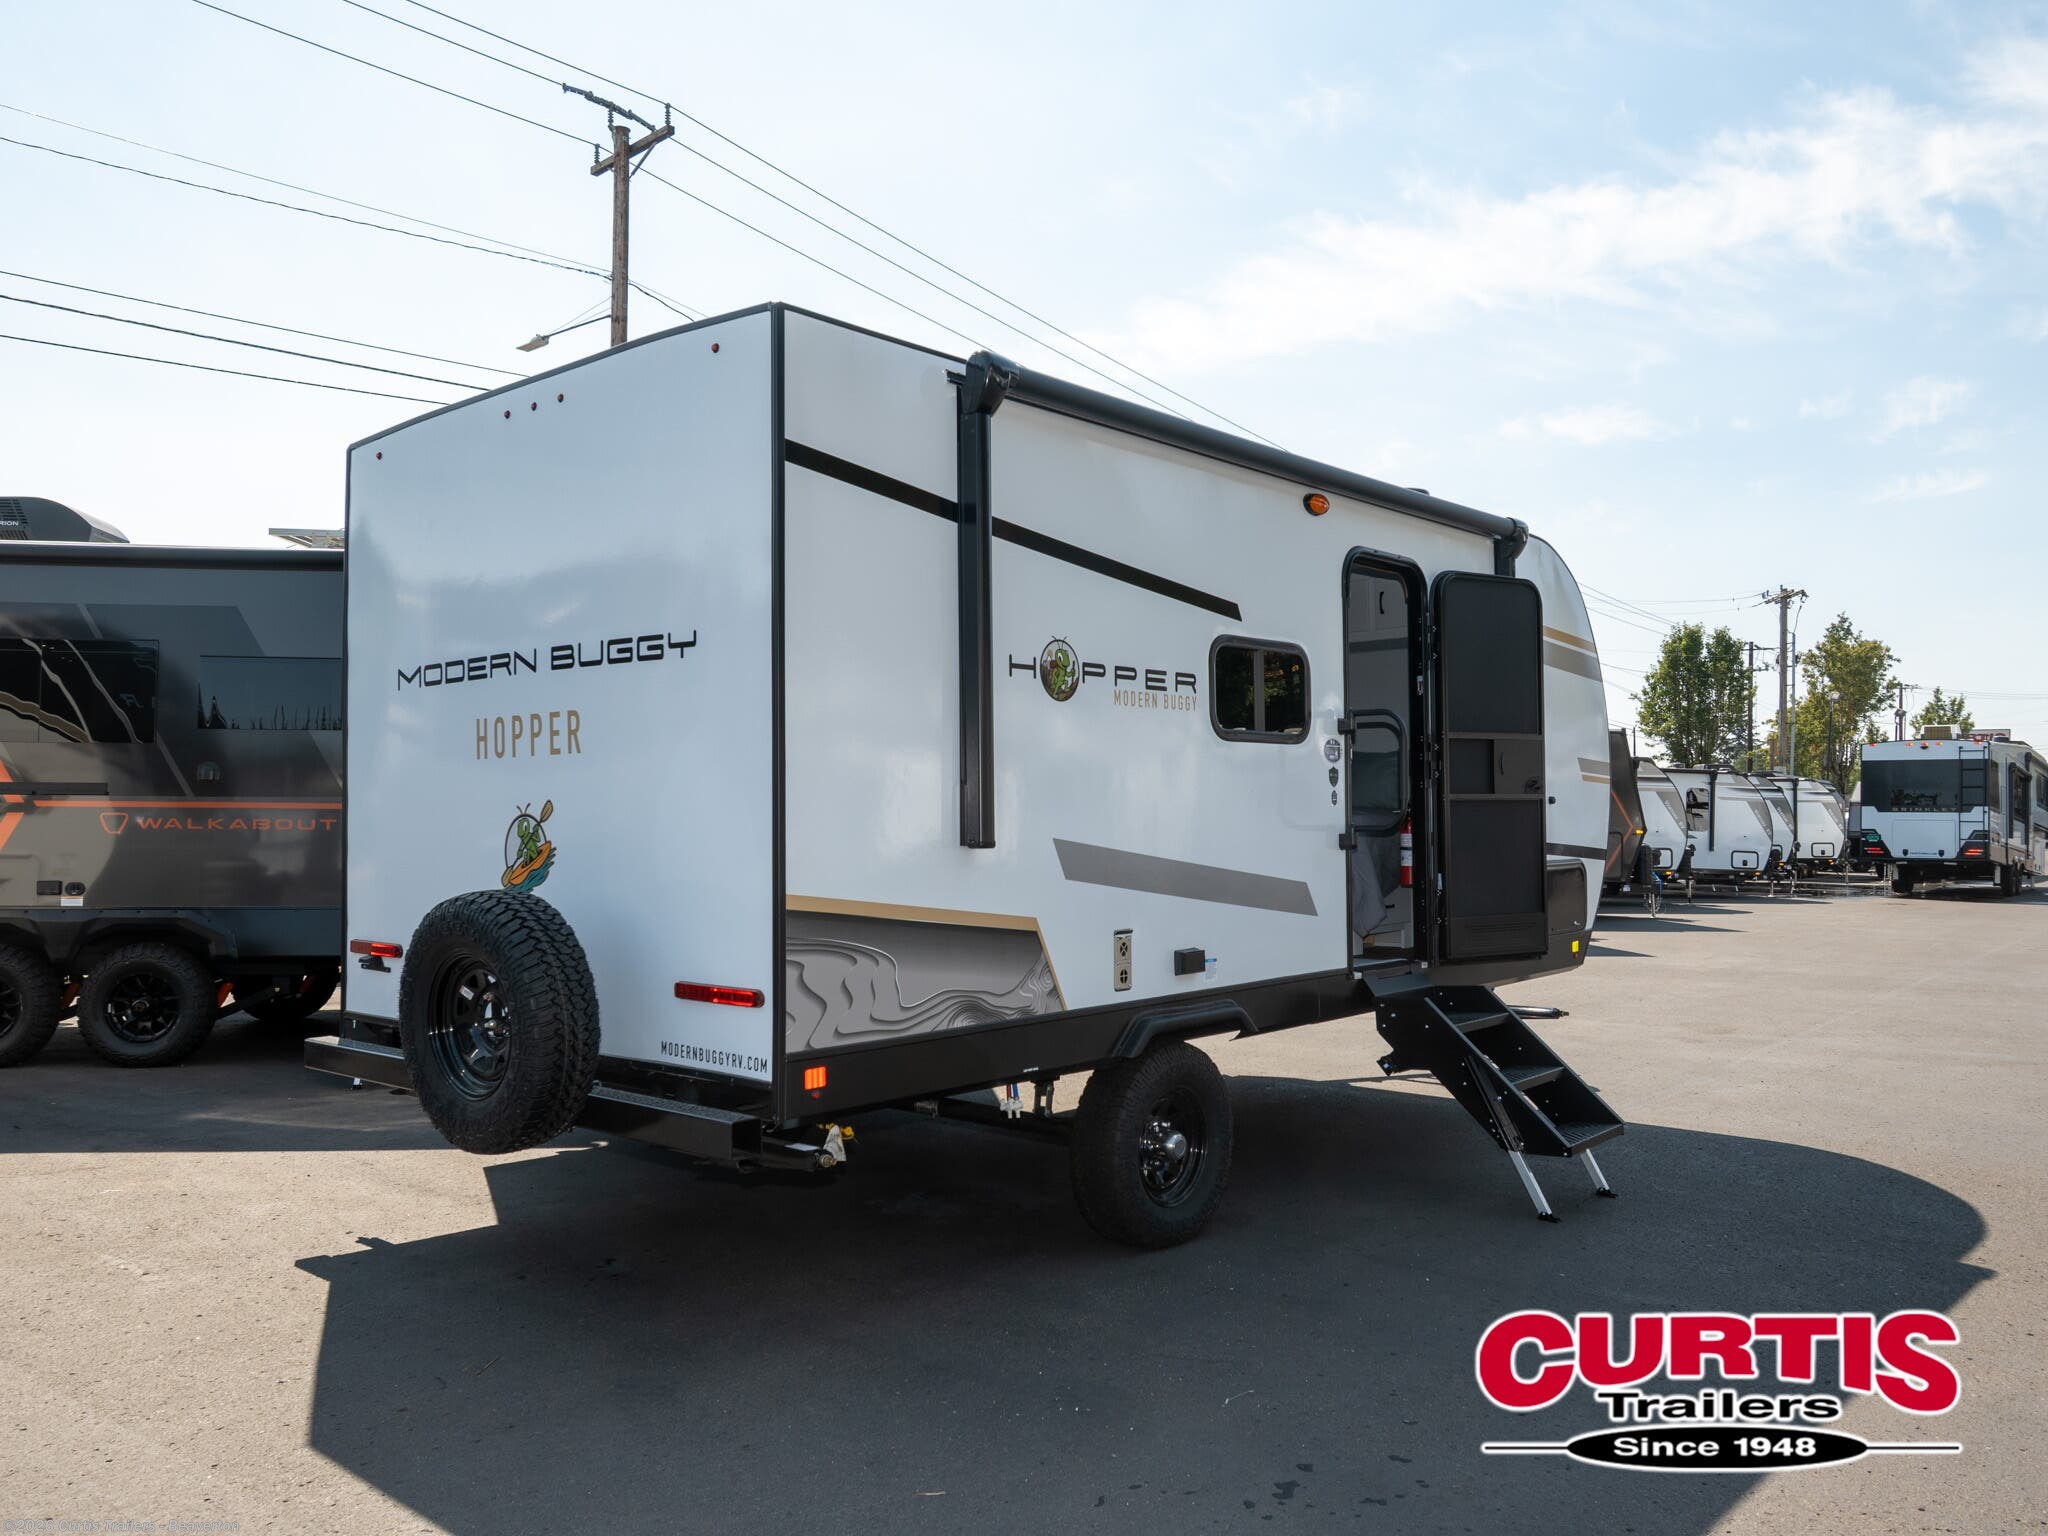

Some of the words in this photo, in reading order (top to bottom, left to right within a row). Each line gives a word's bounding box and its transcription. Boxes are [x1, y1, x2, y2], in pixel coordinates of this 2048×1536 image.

[397, 648, 537, 692] MODERN
[550, 629, 698, 672] BUGGY
[1113, 689, 1159, 709] MODERN
[1163, 693, 1198, 712] BUGGY
[475, 709, 582, 760] HOPPER
[136, 816, 338, 831] WALKABOUT
[660, 1041, 768, 1073] MODERNBUGGYRV.COM
